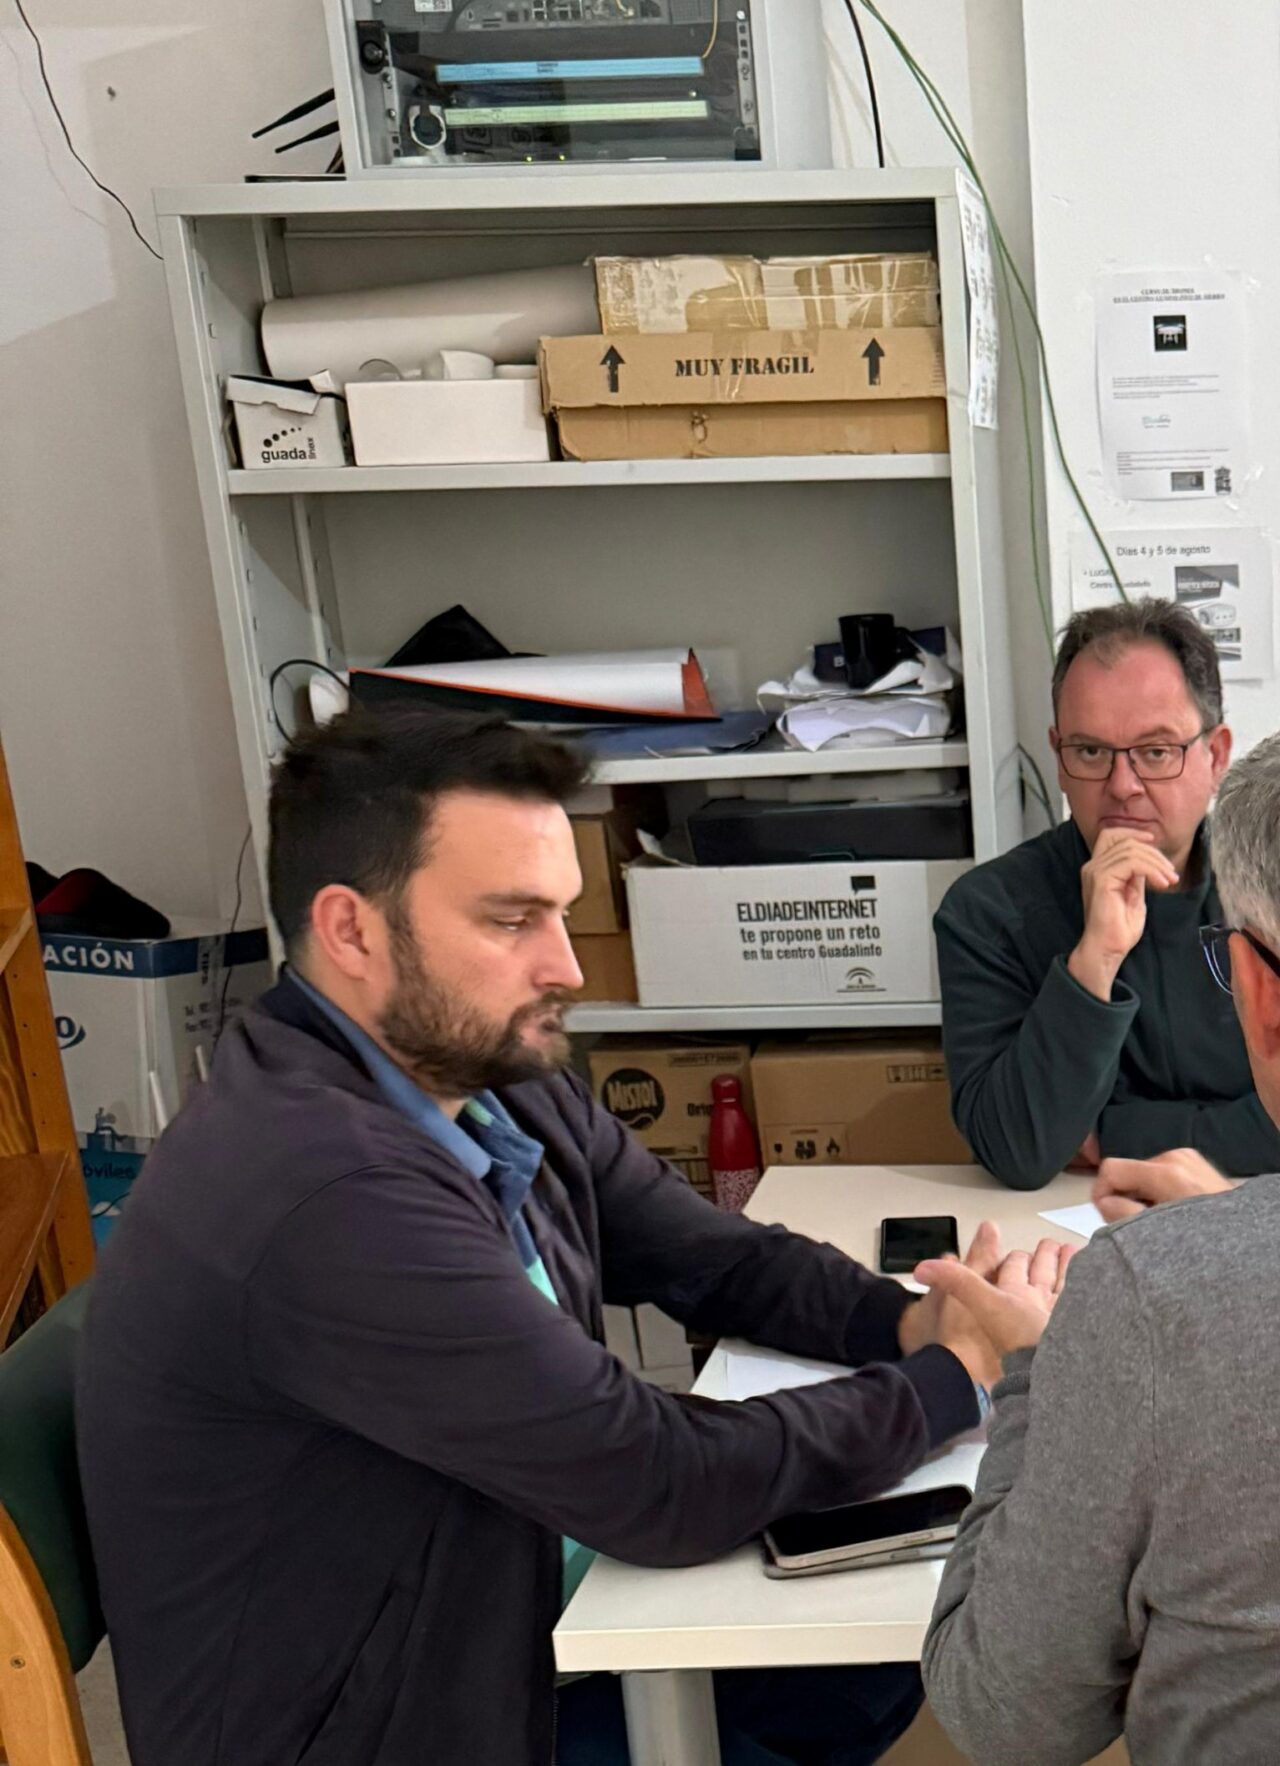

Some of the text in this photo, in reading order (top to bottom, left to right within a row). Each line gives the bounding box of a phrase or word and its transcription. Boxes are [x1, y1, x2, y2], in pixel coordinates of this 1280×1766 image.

[675, 356, 815, 376] MUY FRAGIL
[261, 448, 306, 463] guada
[1116, 547, 1138, 556] Días
[1141, 547, 1146, 555] 4
[1157, 546, 1163, 554] 5
[1165, 546, 1177, 555] de
[1180, 546, 1210, 556] agosto
[737, 898, 877, 922] ELDIADEINTERNET
[741, 925, 880, 946] te propone un reto
[743, 944, 882, 961] en tu centro Guadalinfo
